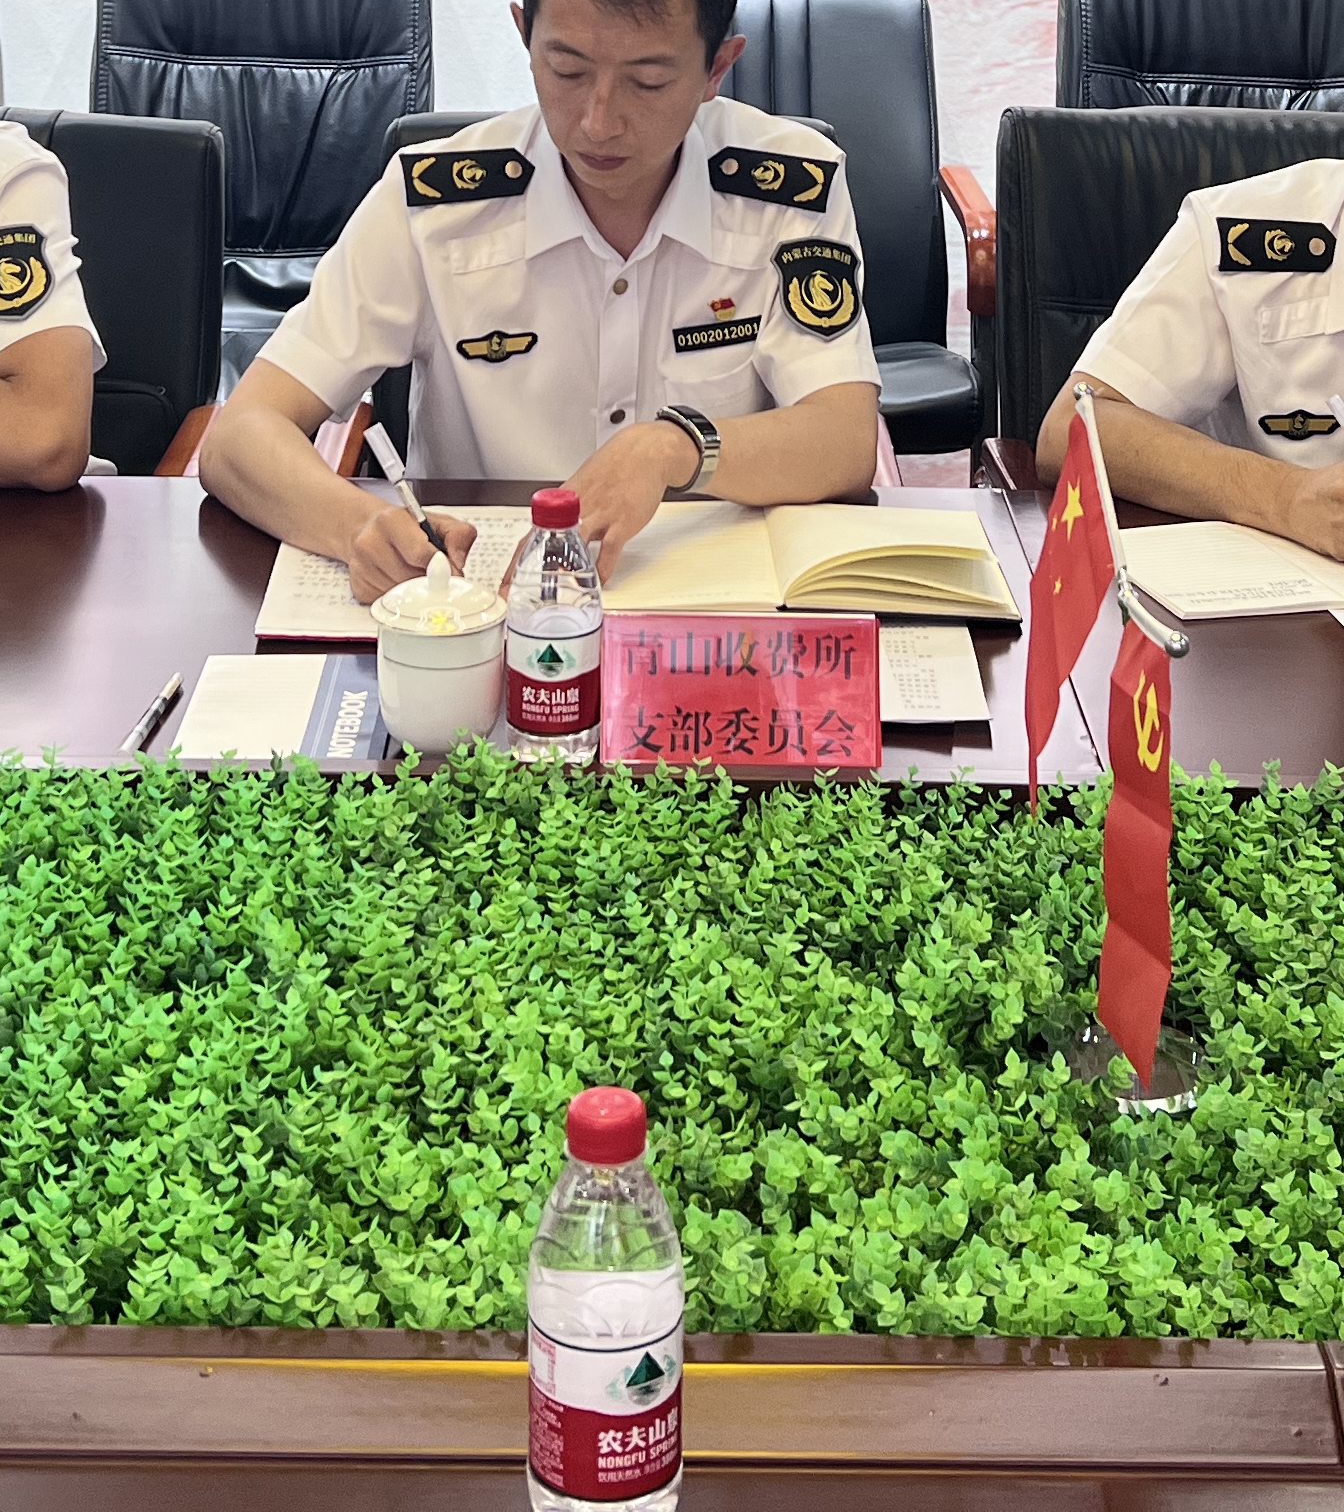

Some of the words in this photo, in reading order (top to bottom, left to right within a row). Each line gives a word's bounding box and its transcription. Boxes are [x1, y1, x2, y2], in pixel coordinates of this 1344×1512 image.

[677, 322, 760, 347] 01002012001
[327, 690, 368, 758] NOTEBOOK
[628, 705, 856, 757] 支部委员会
[598, 1450, 646, 1469] NONGFU
